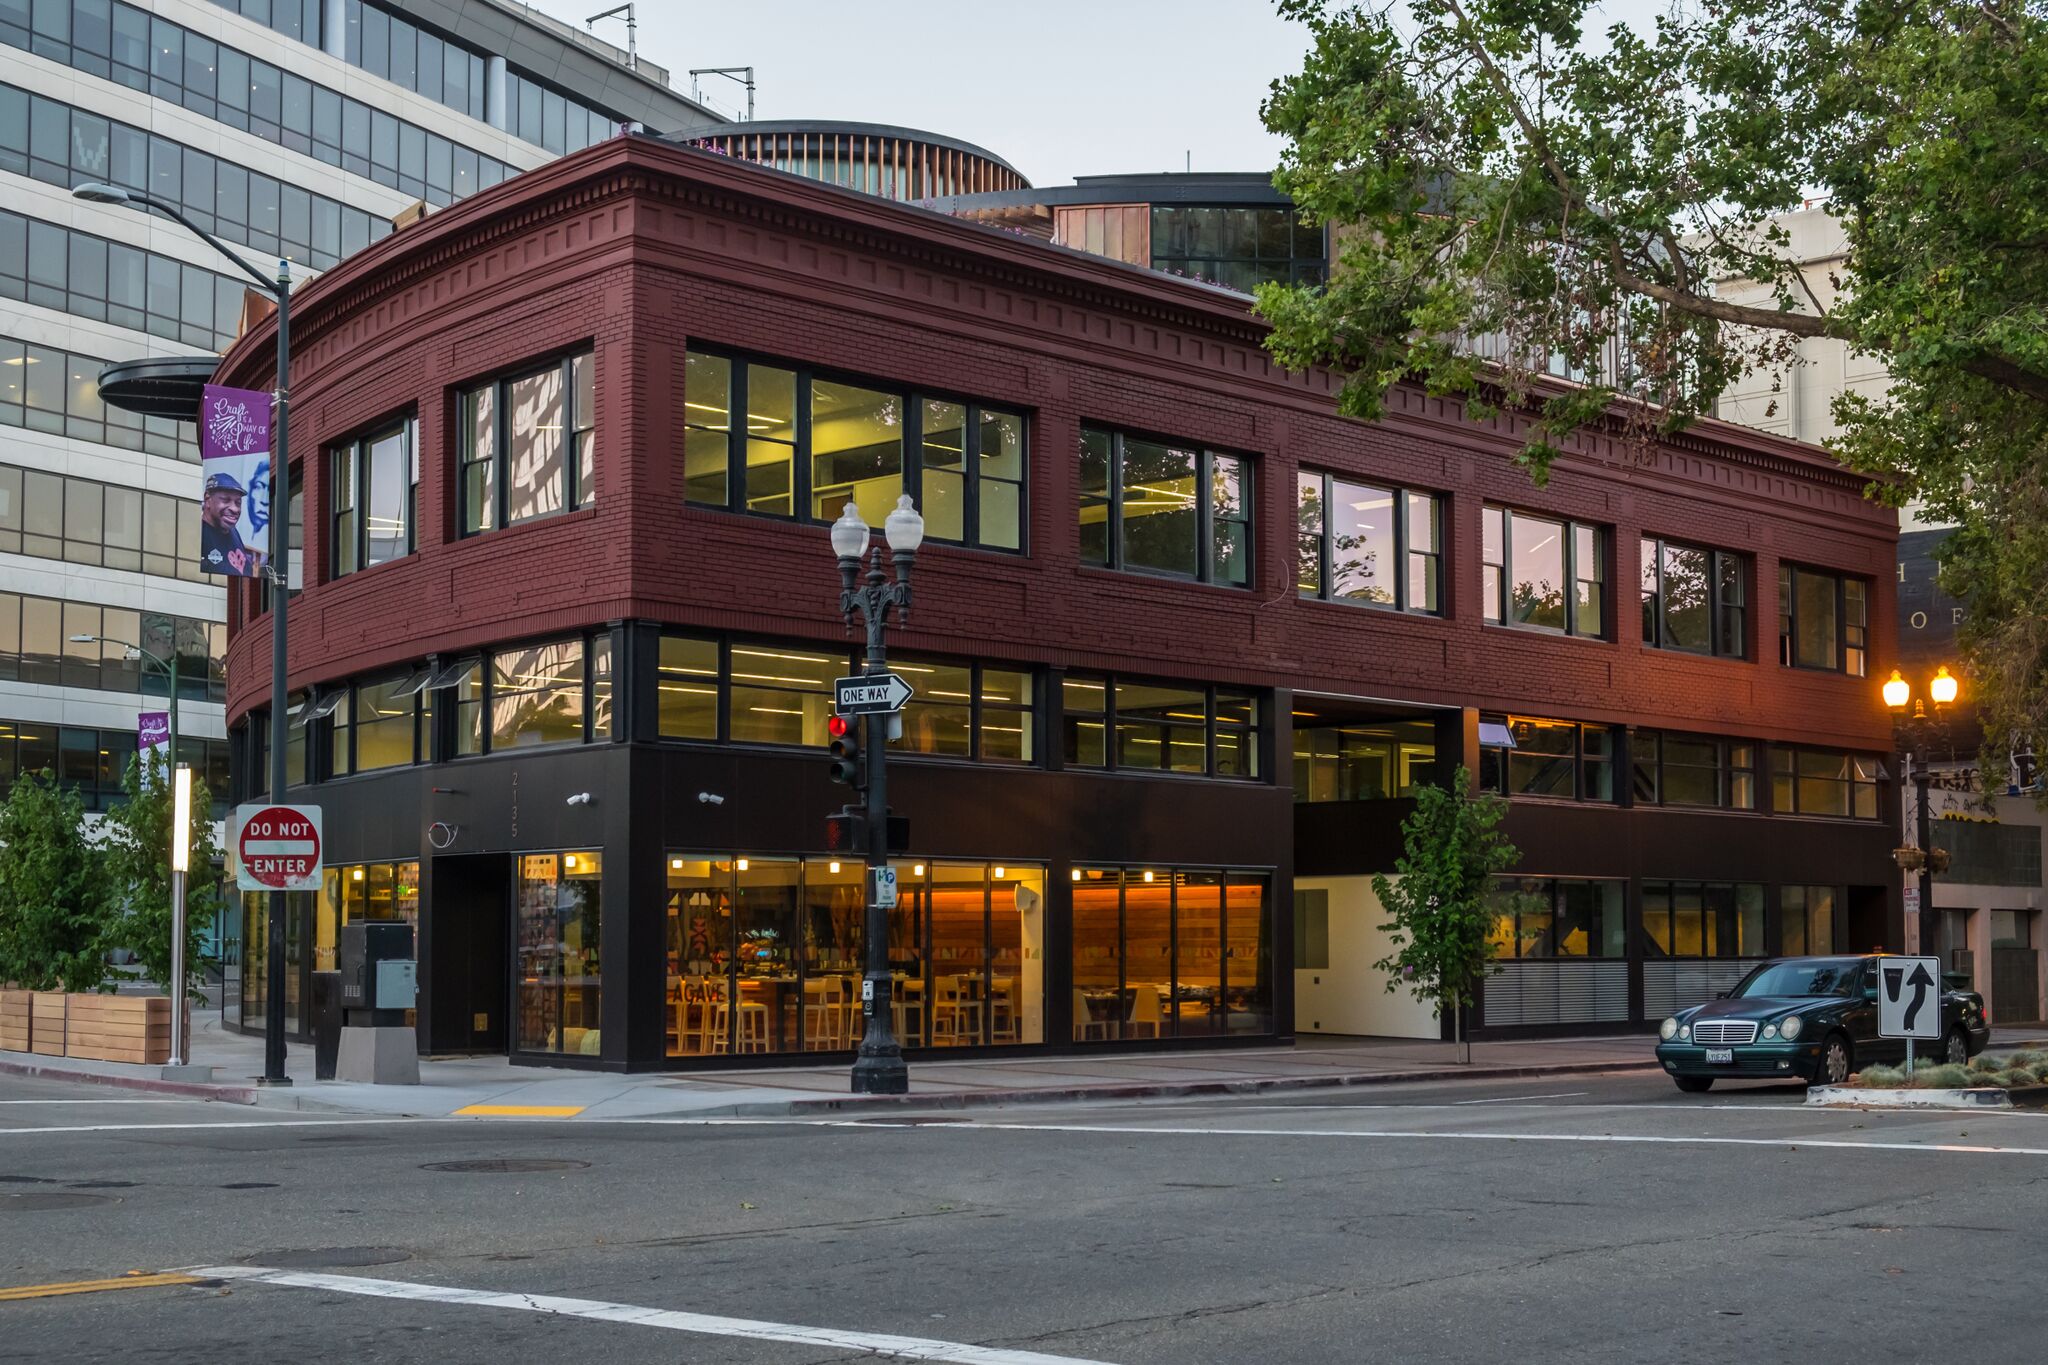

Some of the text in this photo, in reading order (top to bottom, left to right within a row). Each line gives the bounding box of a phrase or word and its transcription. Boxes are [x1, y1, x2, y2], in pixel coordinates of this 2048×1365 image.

[214, 398, 248, 422] Craft
[242, 425, 257, 434] WAY
[843, 687, 889, 702] ONE WAY
[250, 822, 310, 836] DO NOT
[254, 859, 306, 873] ENTER
[672, 983, 726, 1006] AGAVE
